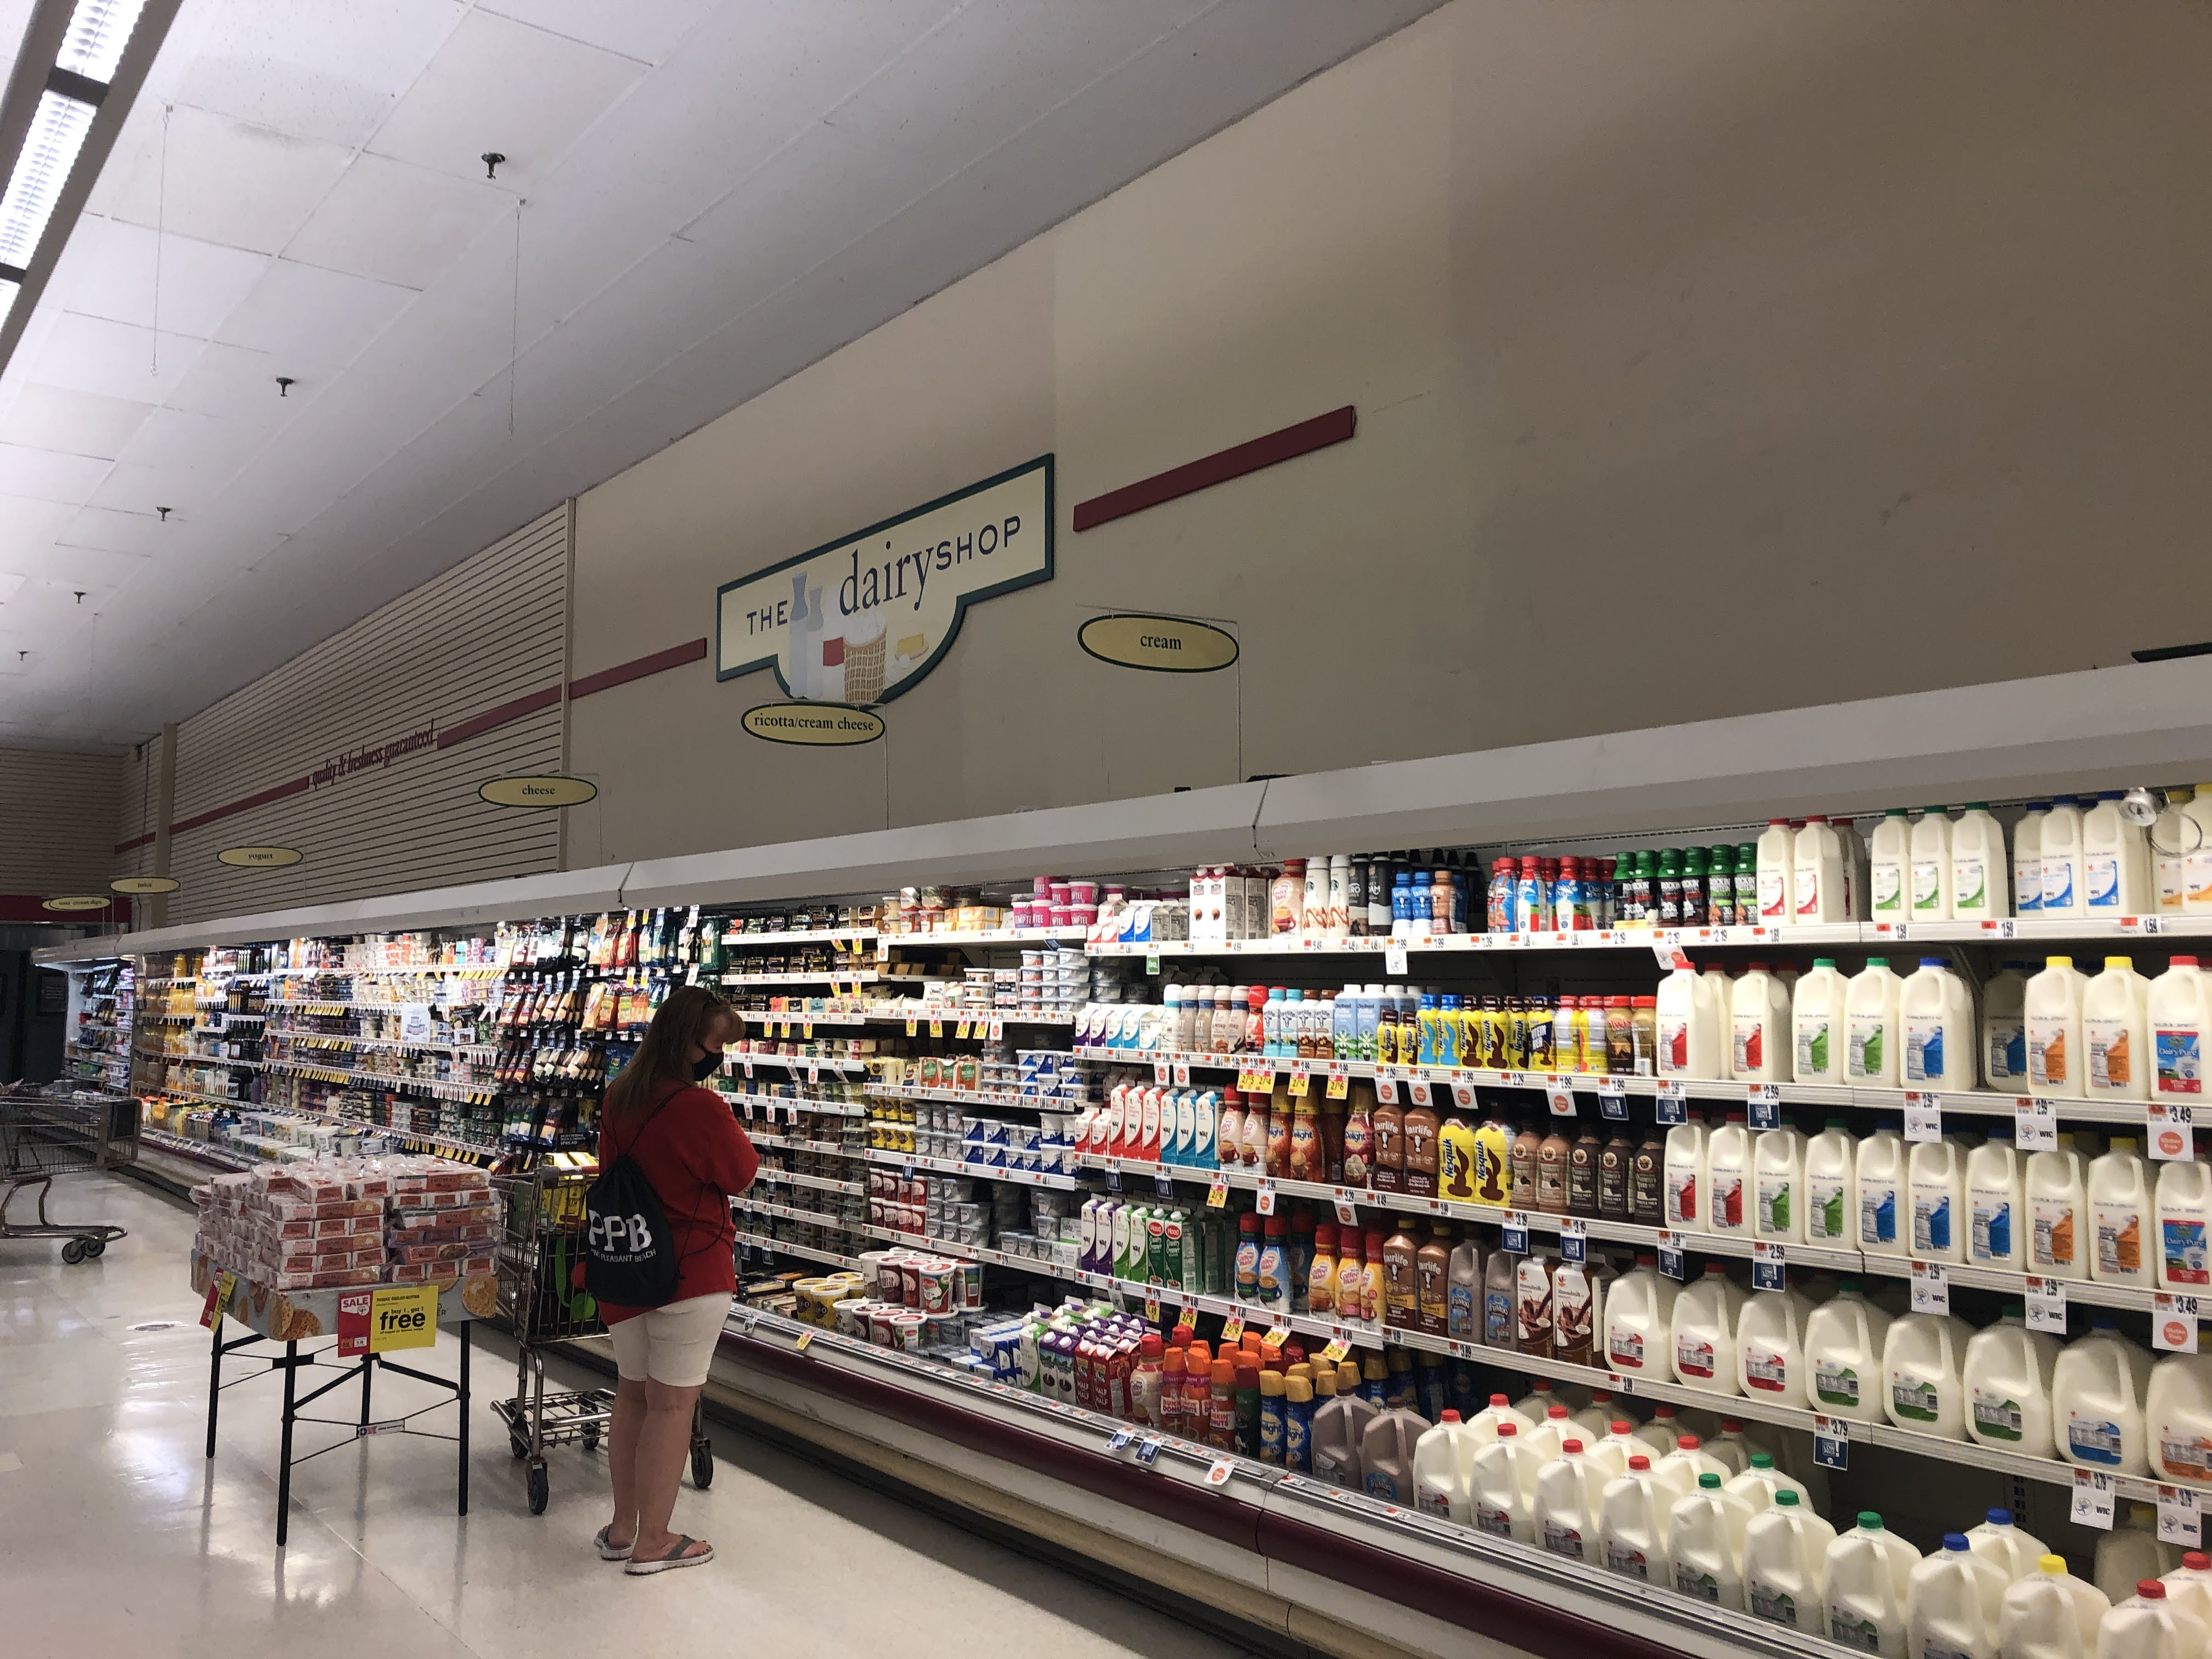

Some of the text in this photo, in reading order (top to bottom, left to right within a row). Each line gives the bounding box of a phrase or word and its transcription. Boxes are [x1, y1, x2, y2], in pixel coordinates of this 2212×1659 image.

[746, 515, 1022, 637] THE dairy SHOP
[1139, 631, 1183, 651] cream
[754, 713, 874, 732] ricotta/cream cheese
[384, 718, 434, 768] guaranteed
[521, 784, 556, 796] cheese
[247, 852, 274, 861] yogurt
[2039, 1130, 2053, 1138] WIC
[1443, 1138, 1455, 1178] Nesquik
[1476, 1140, 1488, 1181] Nesquik
[588, 1209, 652, 1252] PPB
[1150, 1223, 1161, 1232] Hood
[601, 1254, 633, 1262] PLEASANT
[635, 1248, 657, 1262] BEACH
[343, 1296, 369, 1308] SALE
[1932, 1294, 1945, 1303] WIC
[379, 1311, 426, 1330] free
[2049, 1311, 2063, 1321] WIC
[1077, 1381, 1089, 1390] HALF
[1095, 1387, 1107, 1396] HALF
